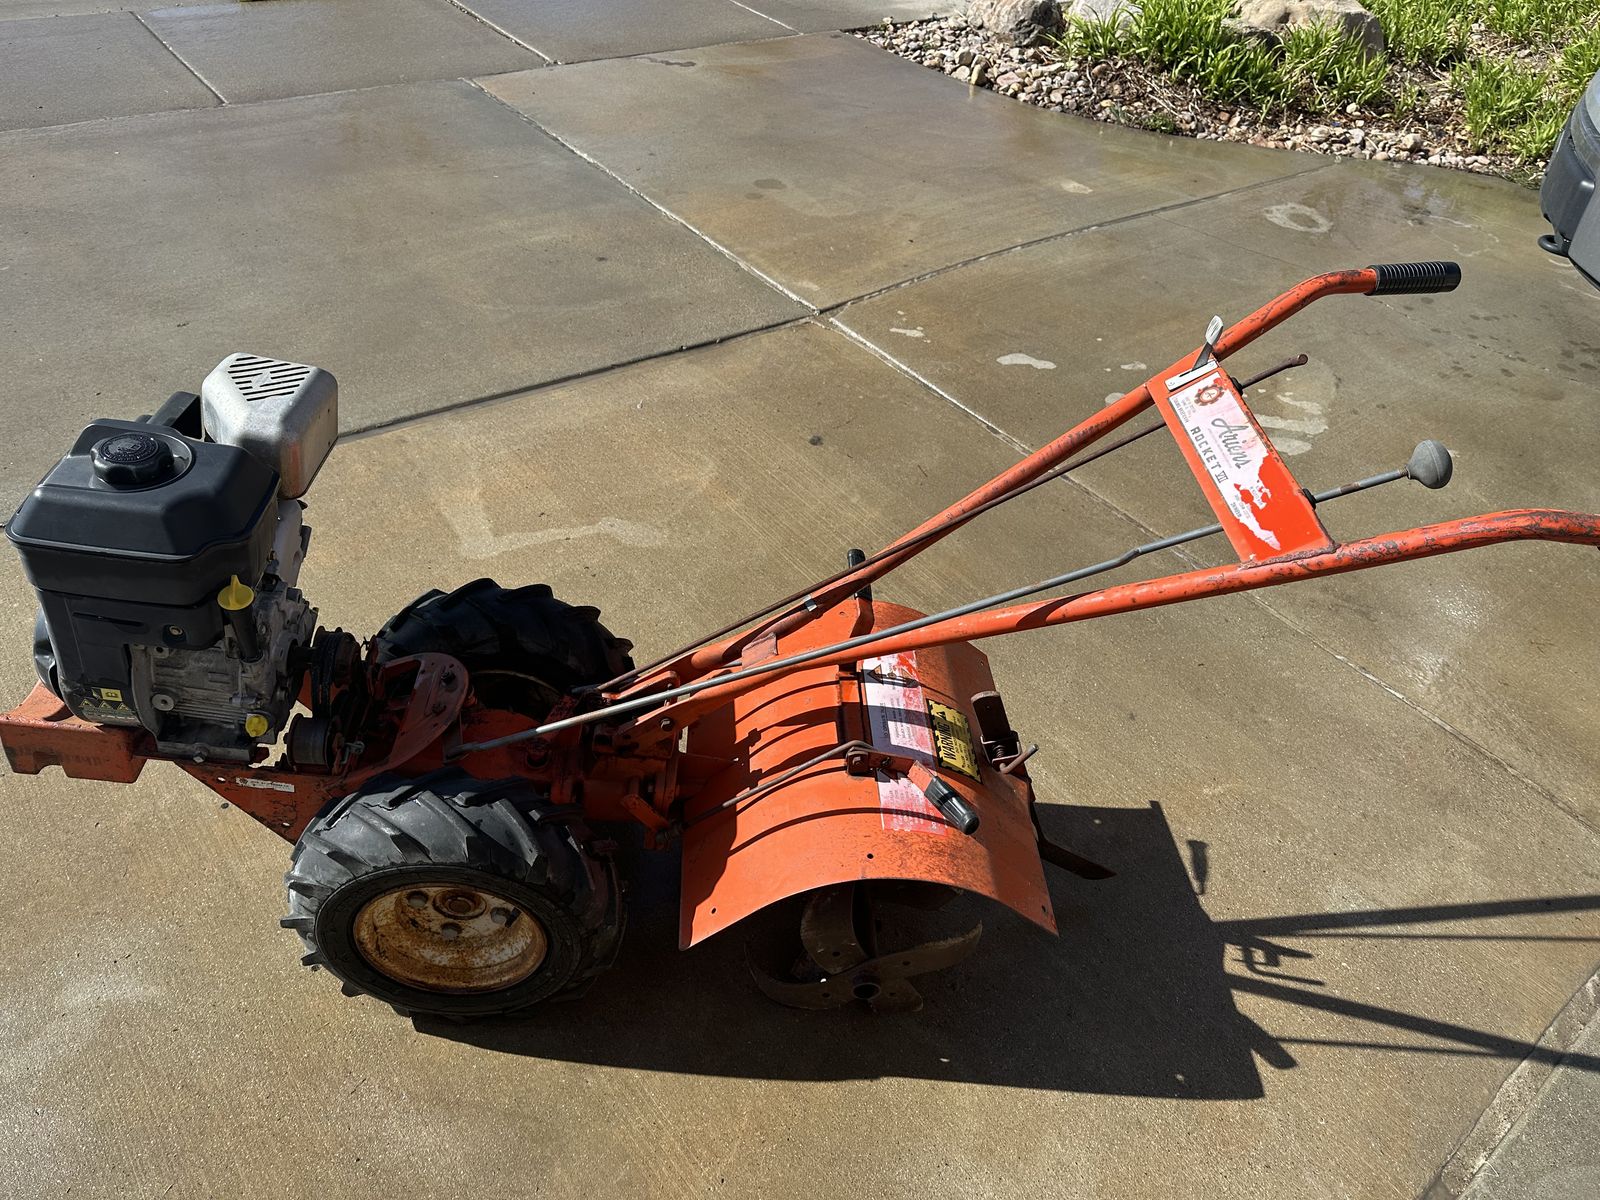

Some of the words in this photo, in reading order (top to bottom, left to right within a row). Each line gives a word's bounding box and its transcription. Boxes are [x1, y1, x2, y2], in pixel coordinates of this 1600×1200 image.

[1190, 426, 1222, 470] ROCKET
[1215, 470, 1229, 484] VII
[1211, 418, 1252, 469] Ariens
[938, 723, 957, 760] WARNING
